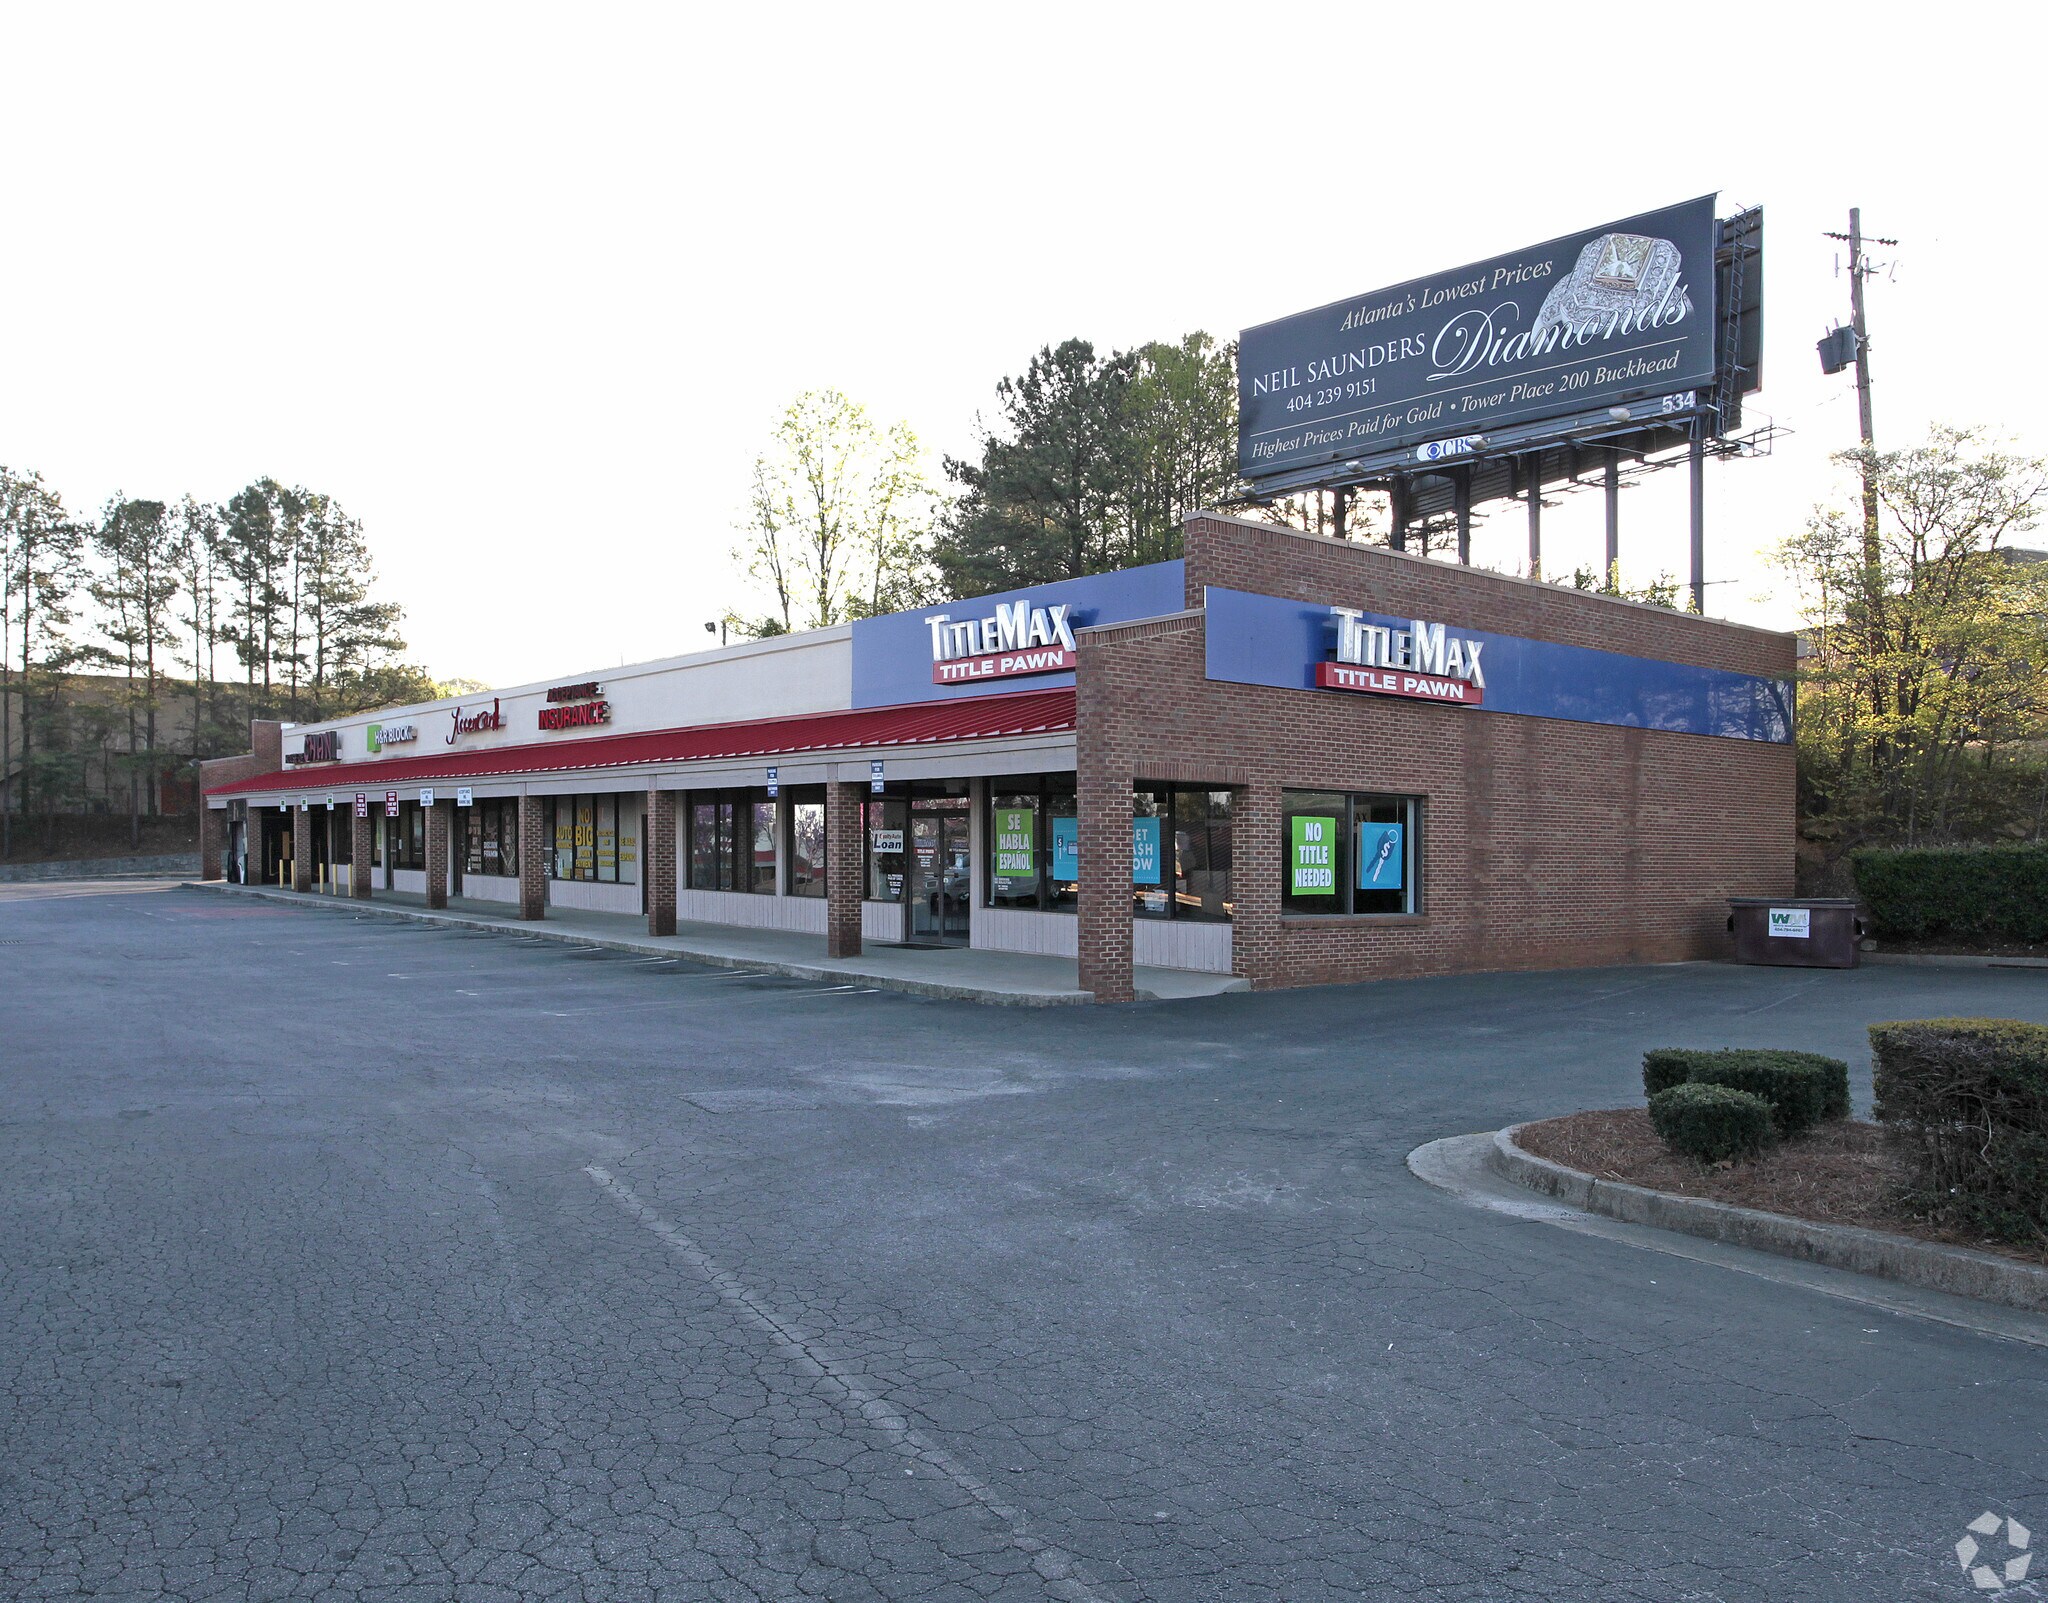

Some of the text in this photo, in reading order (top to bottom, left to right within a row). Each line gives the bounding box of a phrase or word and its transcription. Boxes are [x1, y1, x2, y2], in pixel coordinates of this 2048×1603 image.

[1340, 260, 1553, 331] Atlanta's Lowest Prices
[1426, 272, 1689, 381] Diamonds
[1253, 332, 1426, 397] NEIL SAUNDERS
[1252, 349, 1681, 458] Highest Prices Paid for Gold Tower Place 200 Buckhead
[1286, 377, 1377, 413] 404 239 9151
[1662, 390, 1696, 413] 534
[939, 650, 1063, 679] TITLE PAWN
[1333, 668, 1464, 699] TITLE PAWN
[538, 700, 606, 730] INSURANCE
[374, 725, 411, 745] H&R BLOCK
[579, 807, 591, 824] NO
[1007, 813, 1021, 831] SE
[556, 825, 572, 840] AUTO
[575, 825, 593, 847] BIG
[873, 833, 902, 849] Loan
[999, 833, 1030, 850] HABLA
[1132, 828, 1148, 841] ET
[1305, 822, 1323, 842] NO
[999, 851, 1031, 870] ESPAÑOL
[1132, 857, 1153, 871] OW
[1298, 845, 1328, 865] TITLE
[1295, 868, 1332, 888] NEEDED
